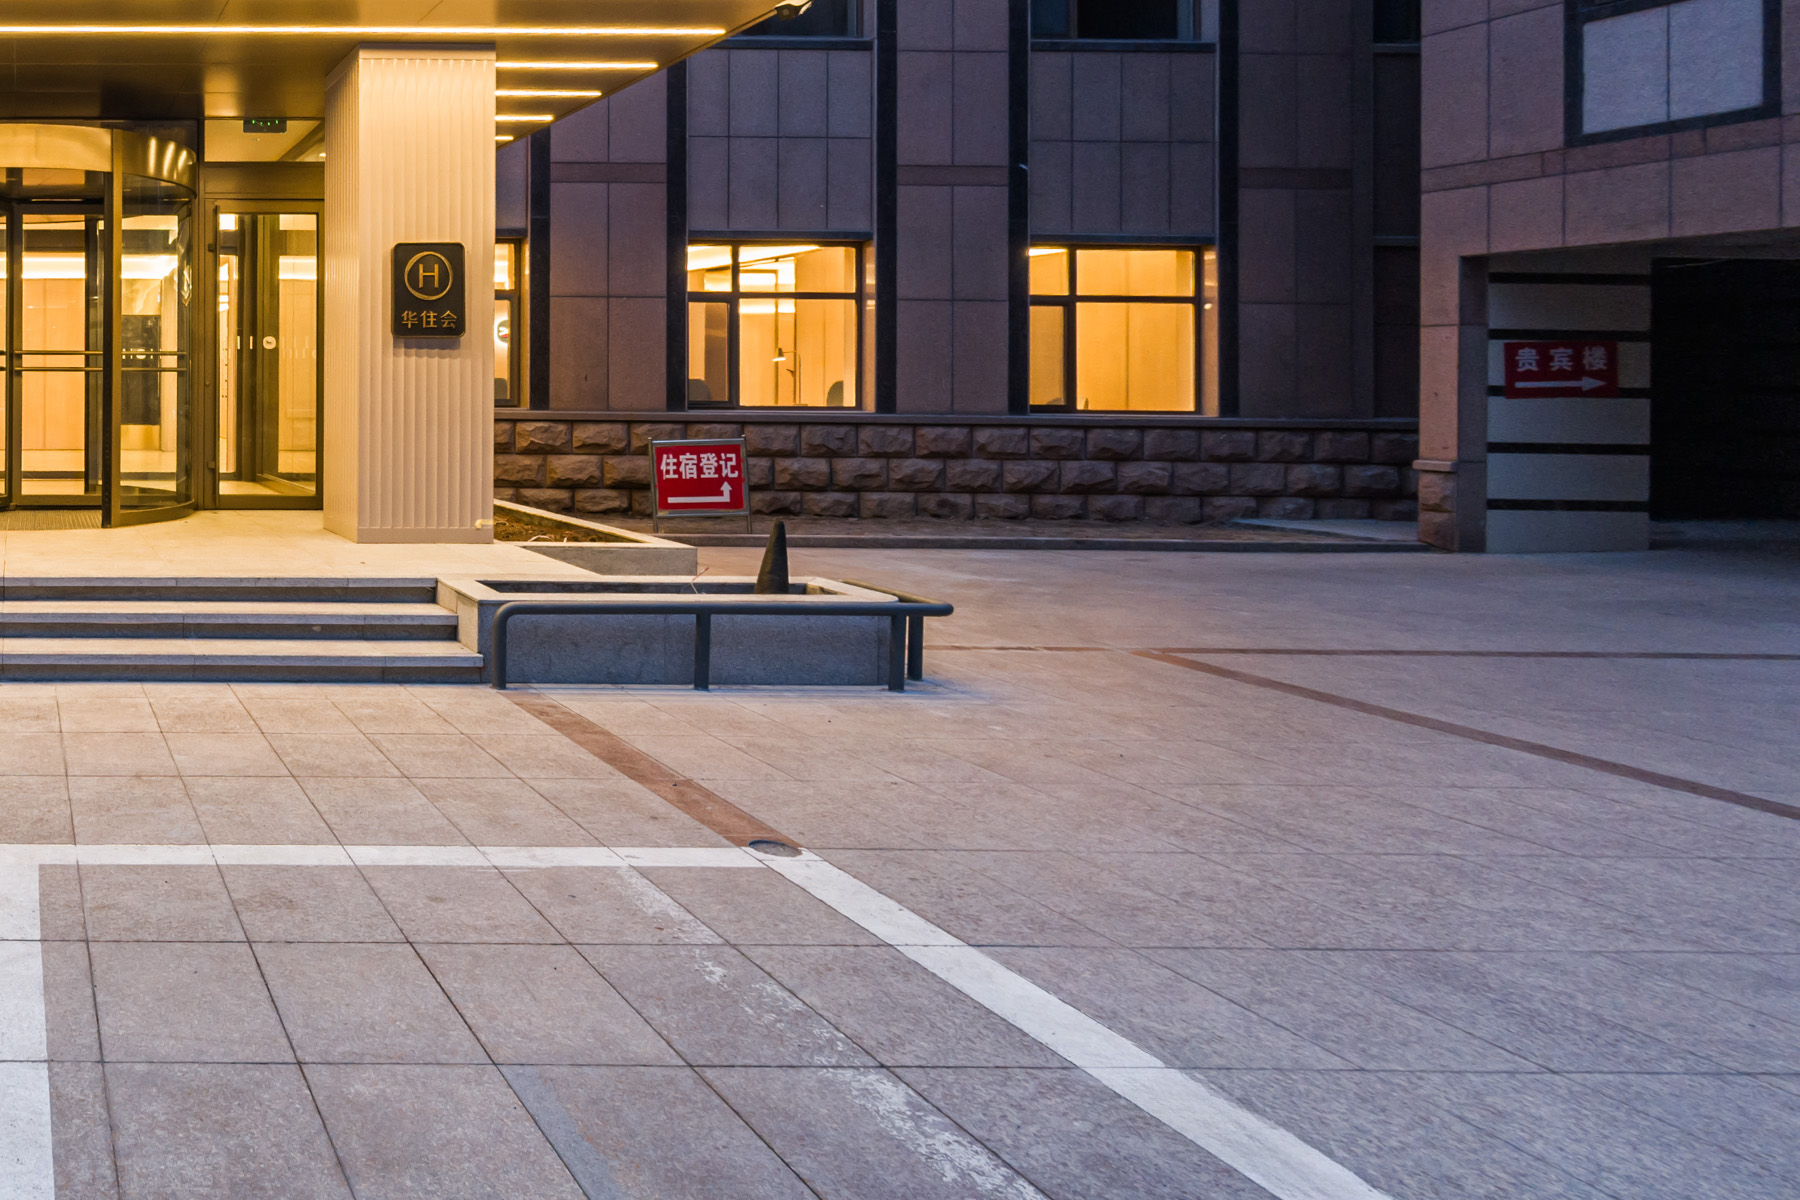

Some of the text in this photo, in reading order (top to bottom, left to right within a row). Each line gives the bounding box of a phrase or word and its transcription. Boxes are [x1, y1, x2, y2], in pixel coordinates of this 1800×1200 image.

[418, 263, 439, 288] H
[401, 310, 457, 328] 华住会
[1515, 346, 1608, 371] 贵宾楼
[660, 453, 739, 479] 住宿登记
